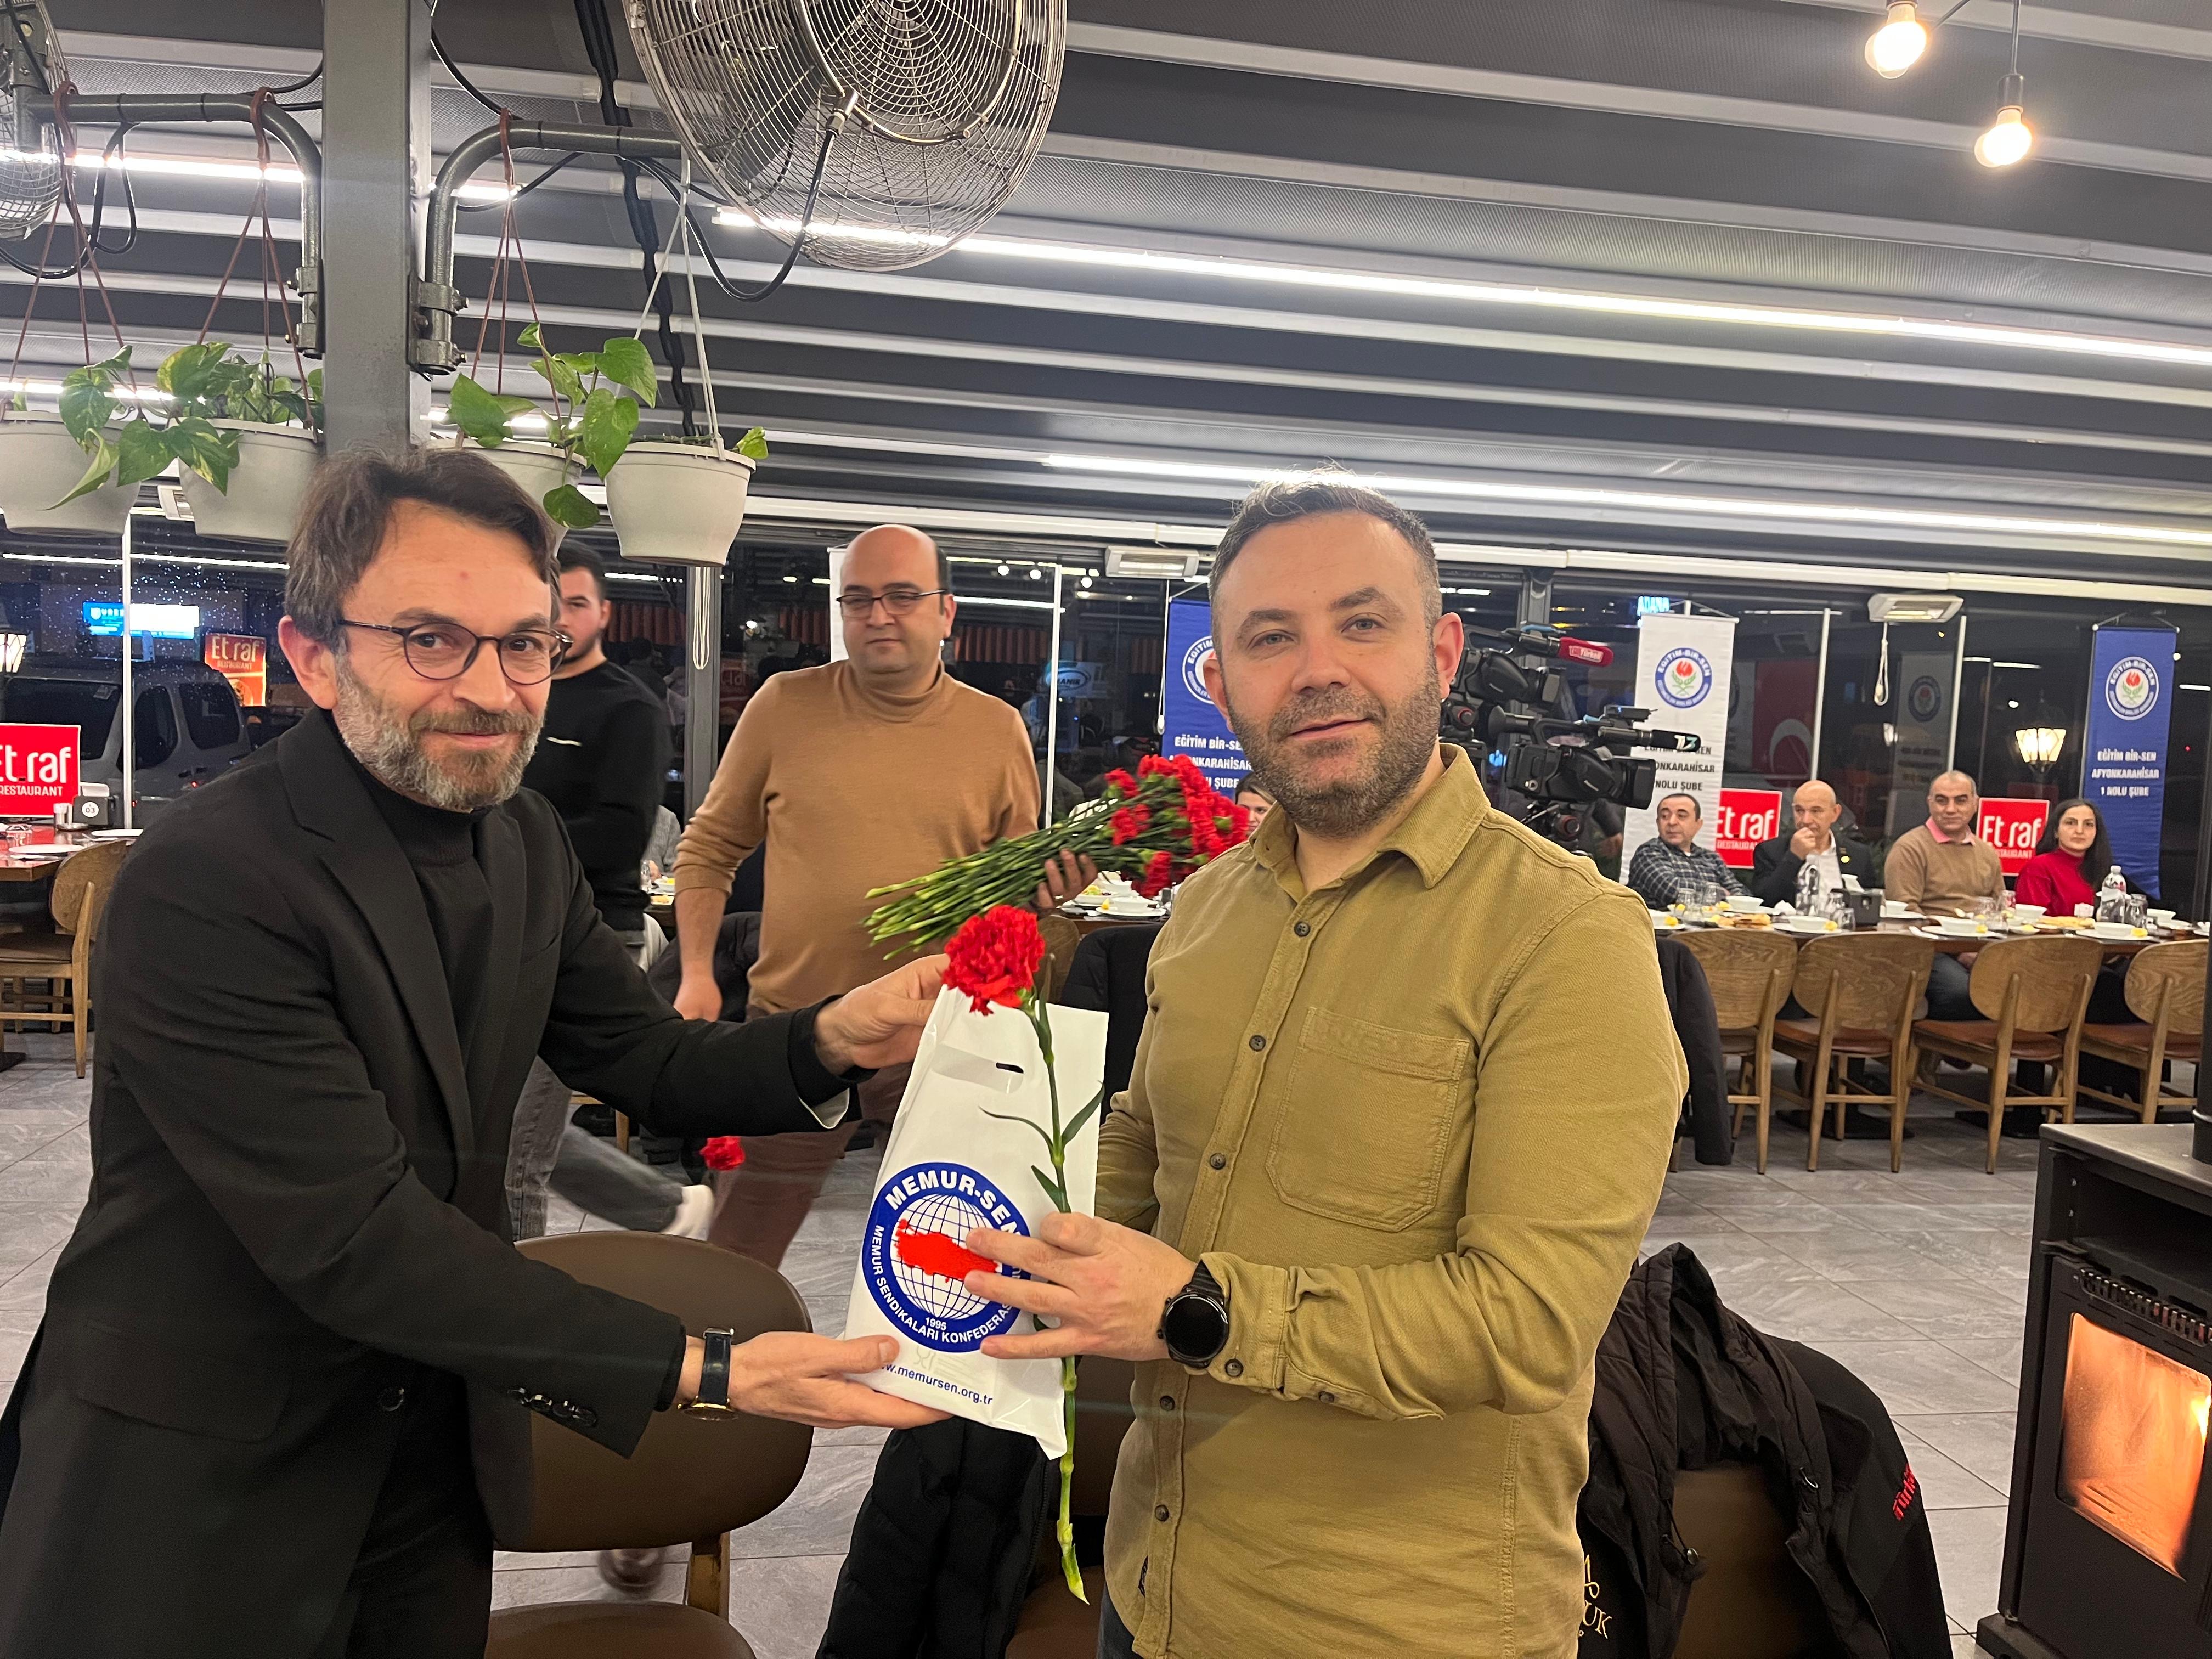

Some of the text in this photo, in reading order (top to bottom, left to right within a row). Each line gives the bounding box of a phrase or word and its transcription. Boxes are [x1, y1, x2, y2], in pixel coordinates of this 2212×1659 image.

[212, 636, 260, 662] Et raf
[1175, 734, 1243, 751] EĞİTİM BİR-SE
[27, 747, 71, 783] raf
[1680, 782, 1702, 793] ŞUBE
[1740, 809, 1774, 840] raf
[2008, 818, 2042, 848] raf
[871, 1225, 884, 1275] MEMUR
[926, 1317, 947, 1330] 1995
[882, 1364, 993, 1404] w.memursen.org.tr
